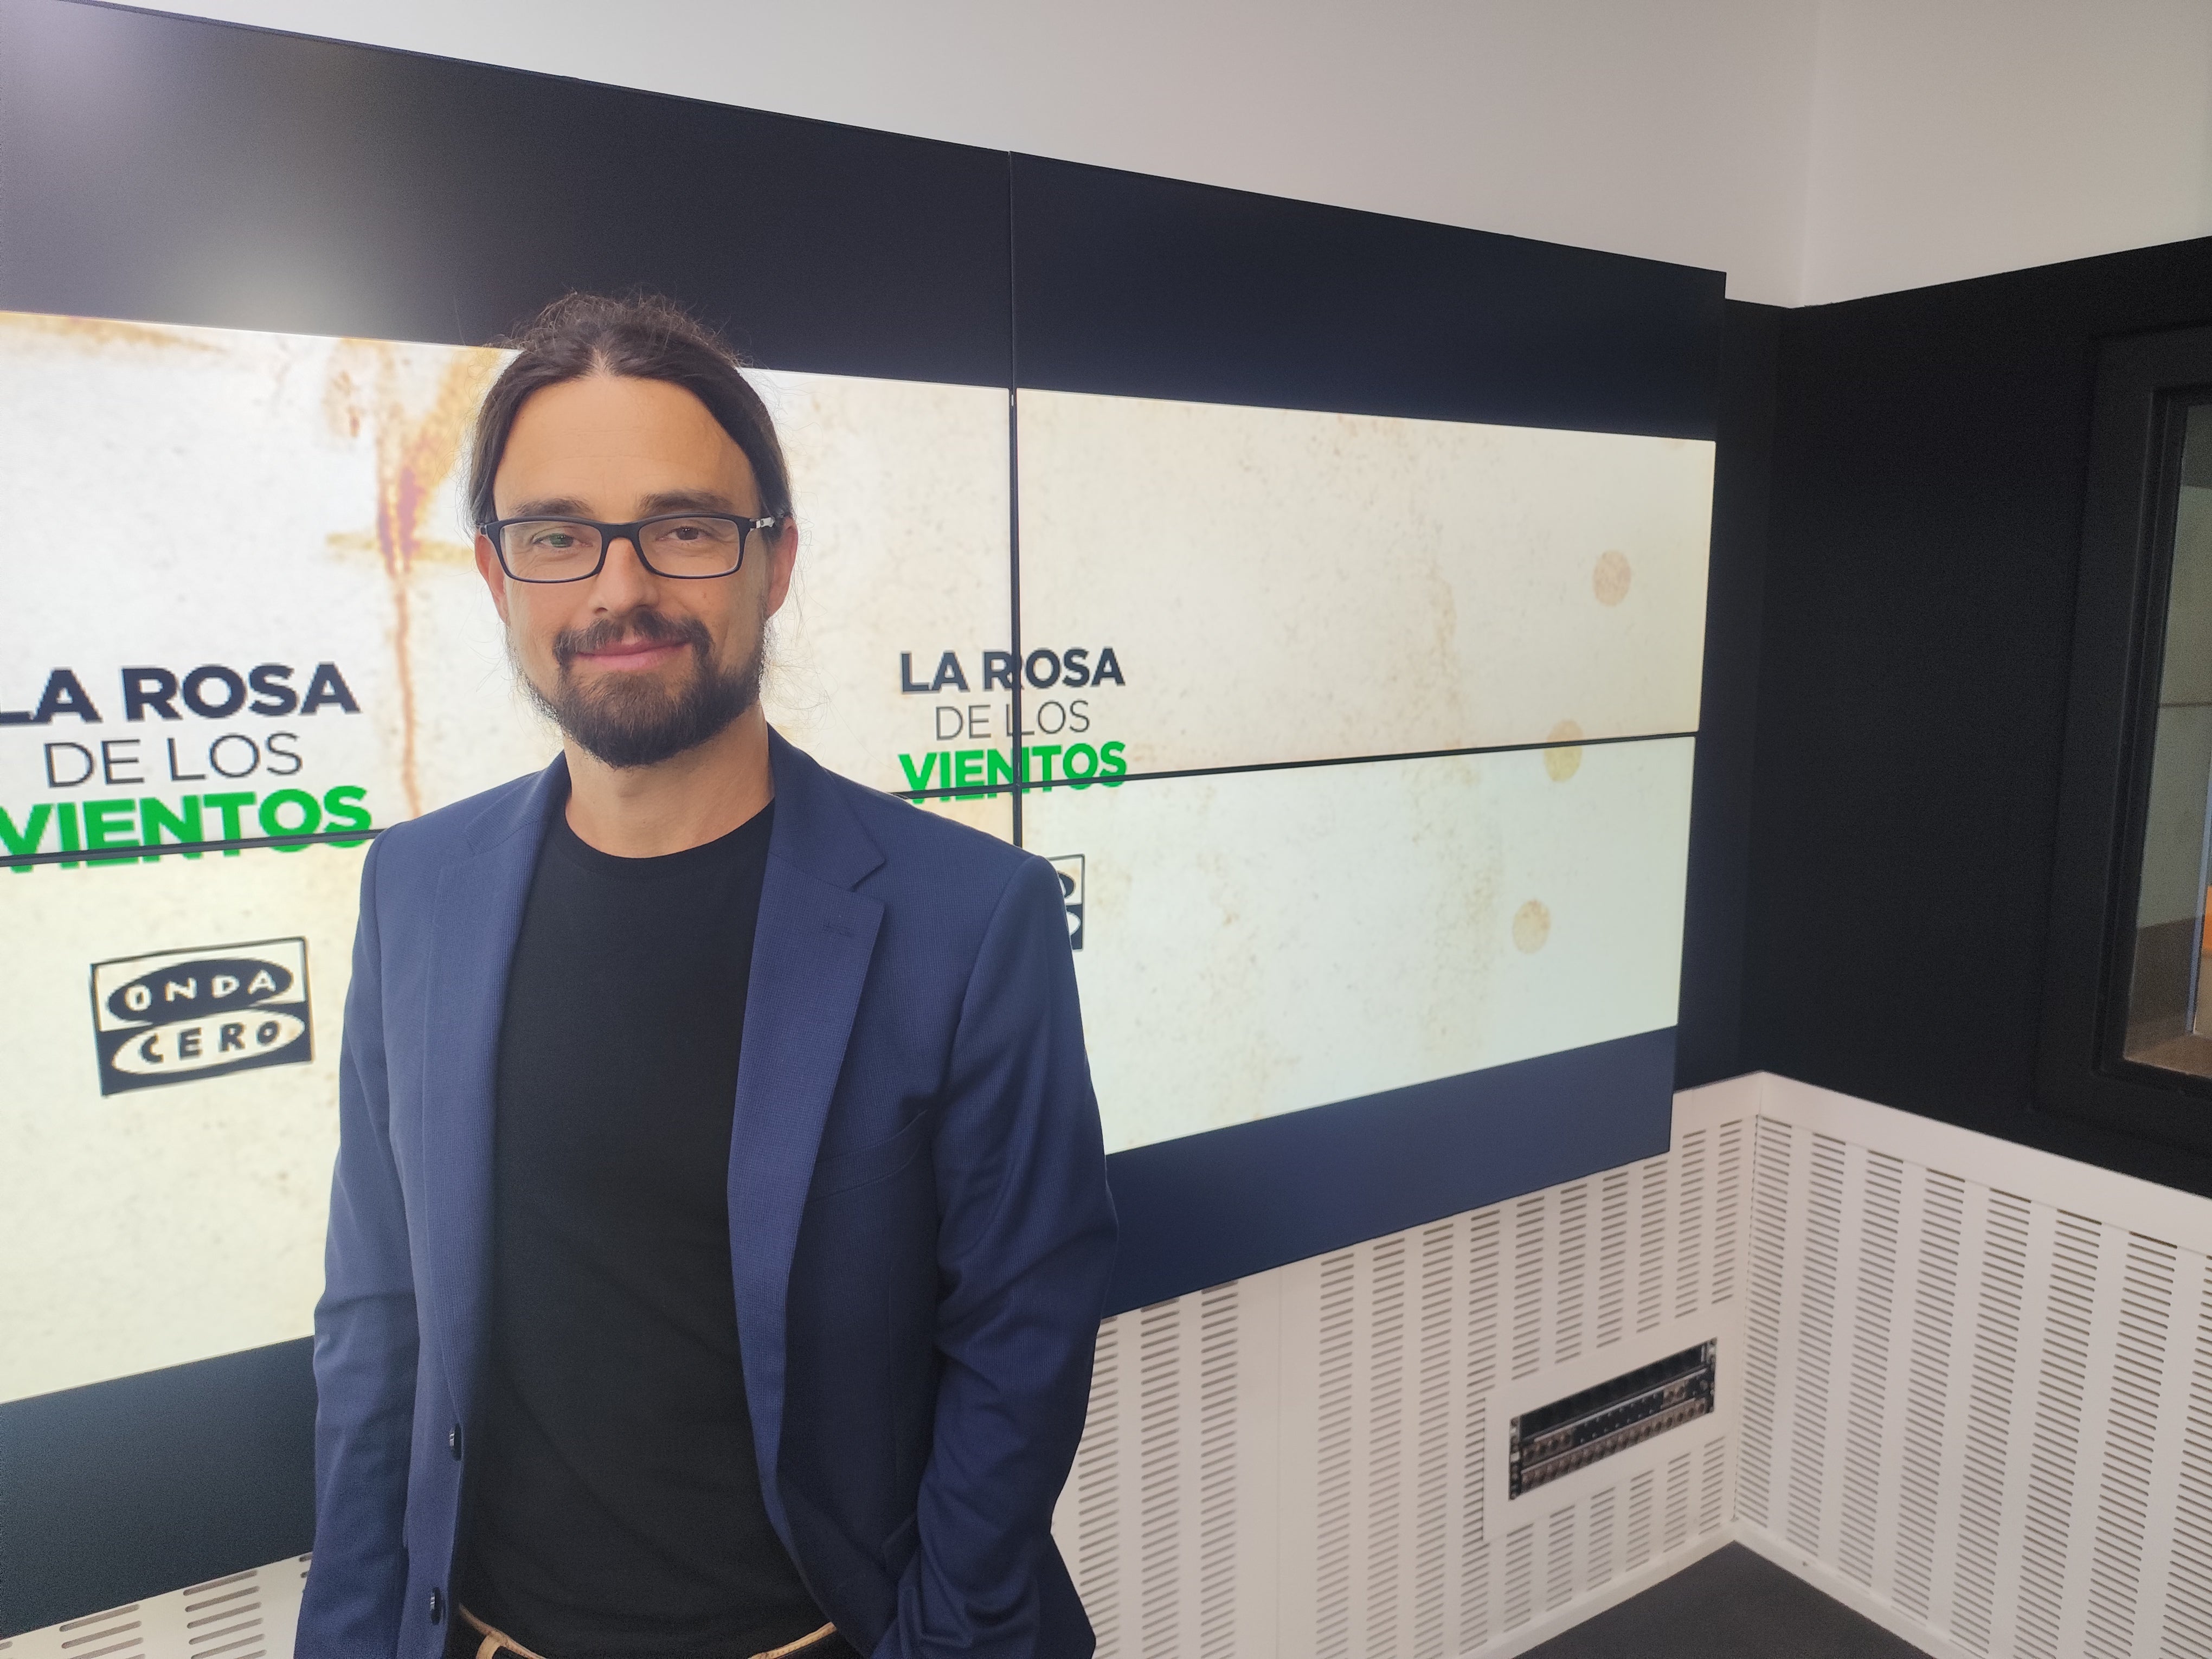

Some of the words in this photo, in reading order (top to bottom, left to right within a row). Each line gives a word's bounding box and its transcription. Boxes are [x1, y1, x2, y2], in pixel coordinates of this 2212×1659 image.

[121, 662, 361, 722] ROSA
[900, 651, 969, 693] LA
[982, 647, 1126, 691] ROSA
[935, 704, 992, 741] DE
[1006, 699, 1090, 737] LOS
[44, 738, 145, 788] DE
[168, 732, 303, 781] LOS
[898, 741, 1127, 804] VIENTOS
[0, 785, 371, 873] VIENTOS
[124, 969, 276, 1011] ONDA
[140, 1020, 281, 1063] CERO
